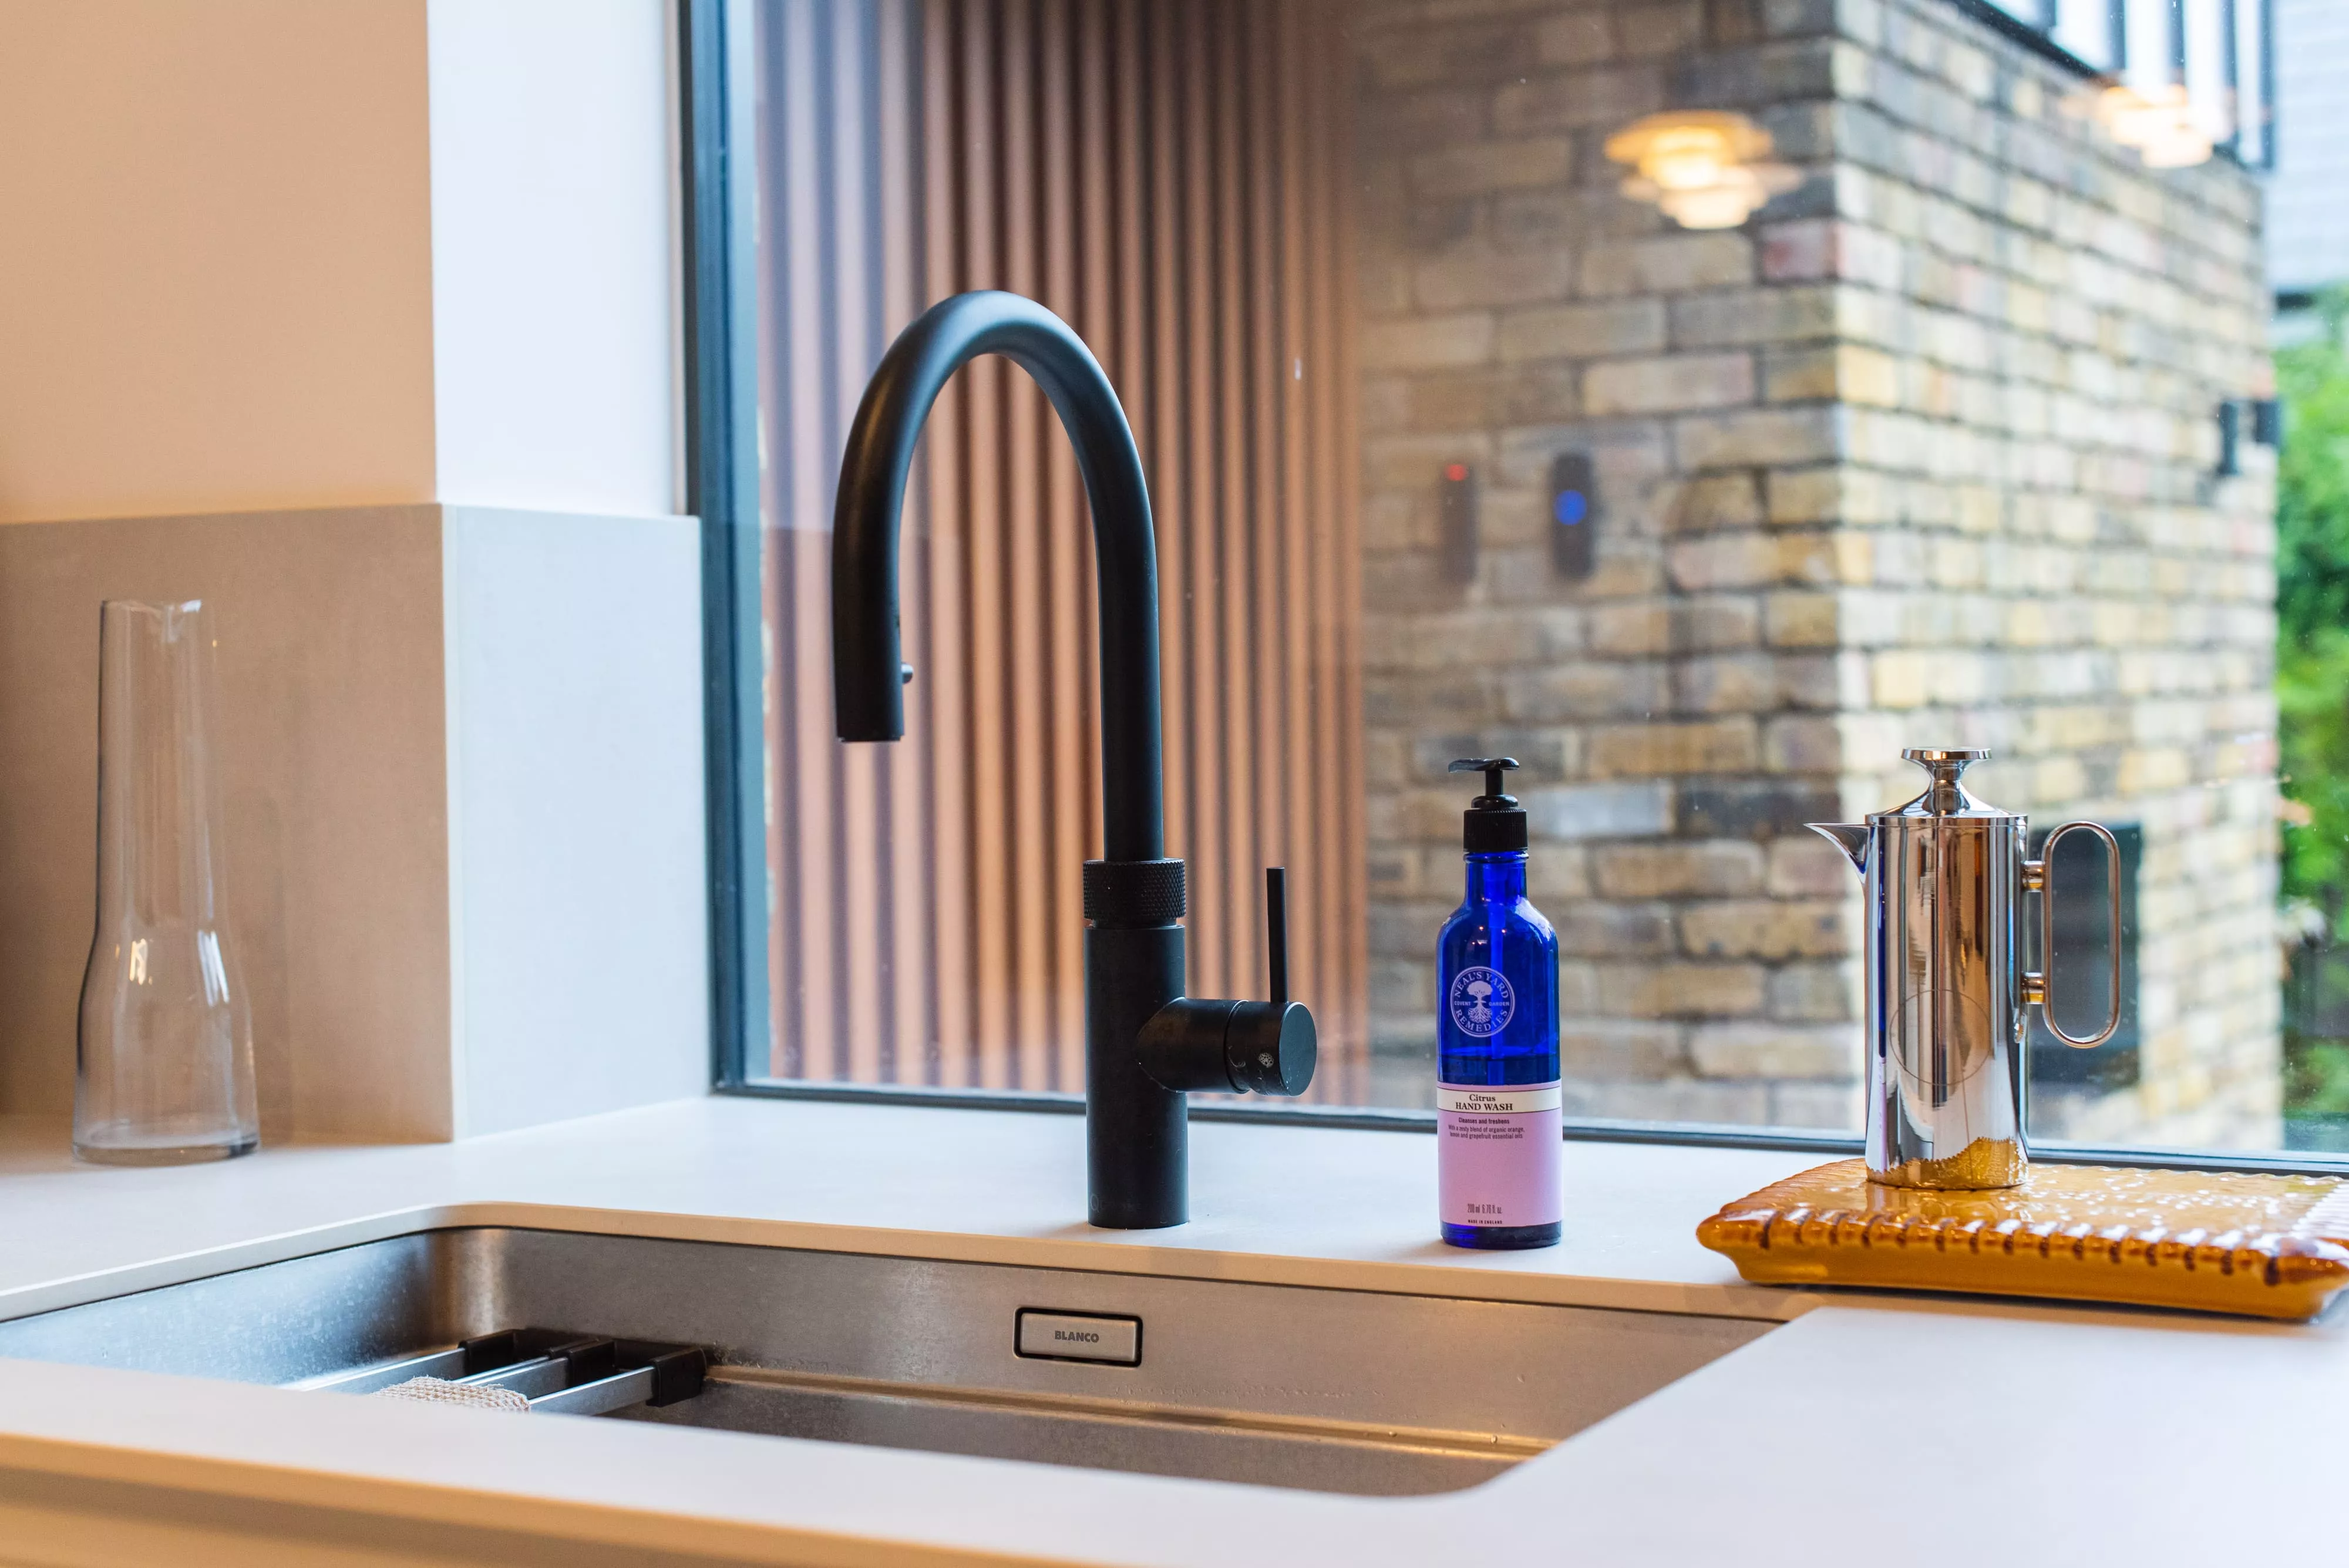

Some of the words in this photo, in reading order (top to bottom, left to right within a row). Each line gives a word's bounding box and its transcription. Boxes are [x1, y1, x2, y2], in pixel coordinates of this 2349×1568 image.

[1455, 971, 1482, 998] NEAL'S
[1486, 973, 1509, 998] YARD
[1456, 1010, 1507, 1032] REMEDIES
[1469, 1093, 1496, 1102] Citrus
[1456, 1102, 1481, 1111] HAND
[1483, 1103, 1513, 1111] WASH
[1054, 1330, 1099, 1343] BLANCO
